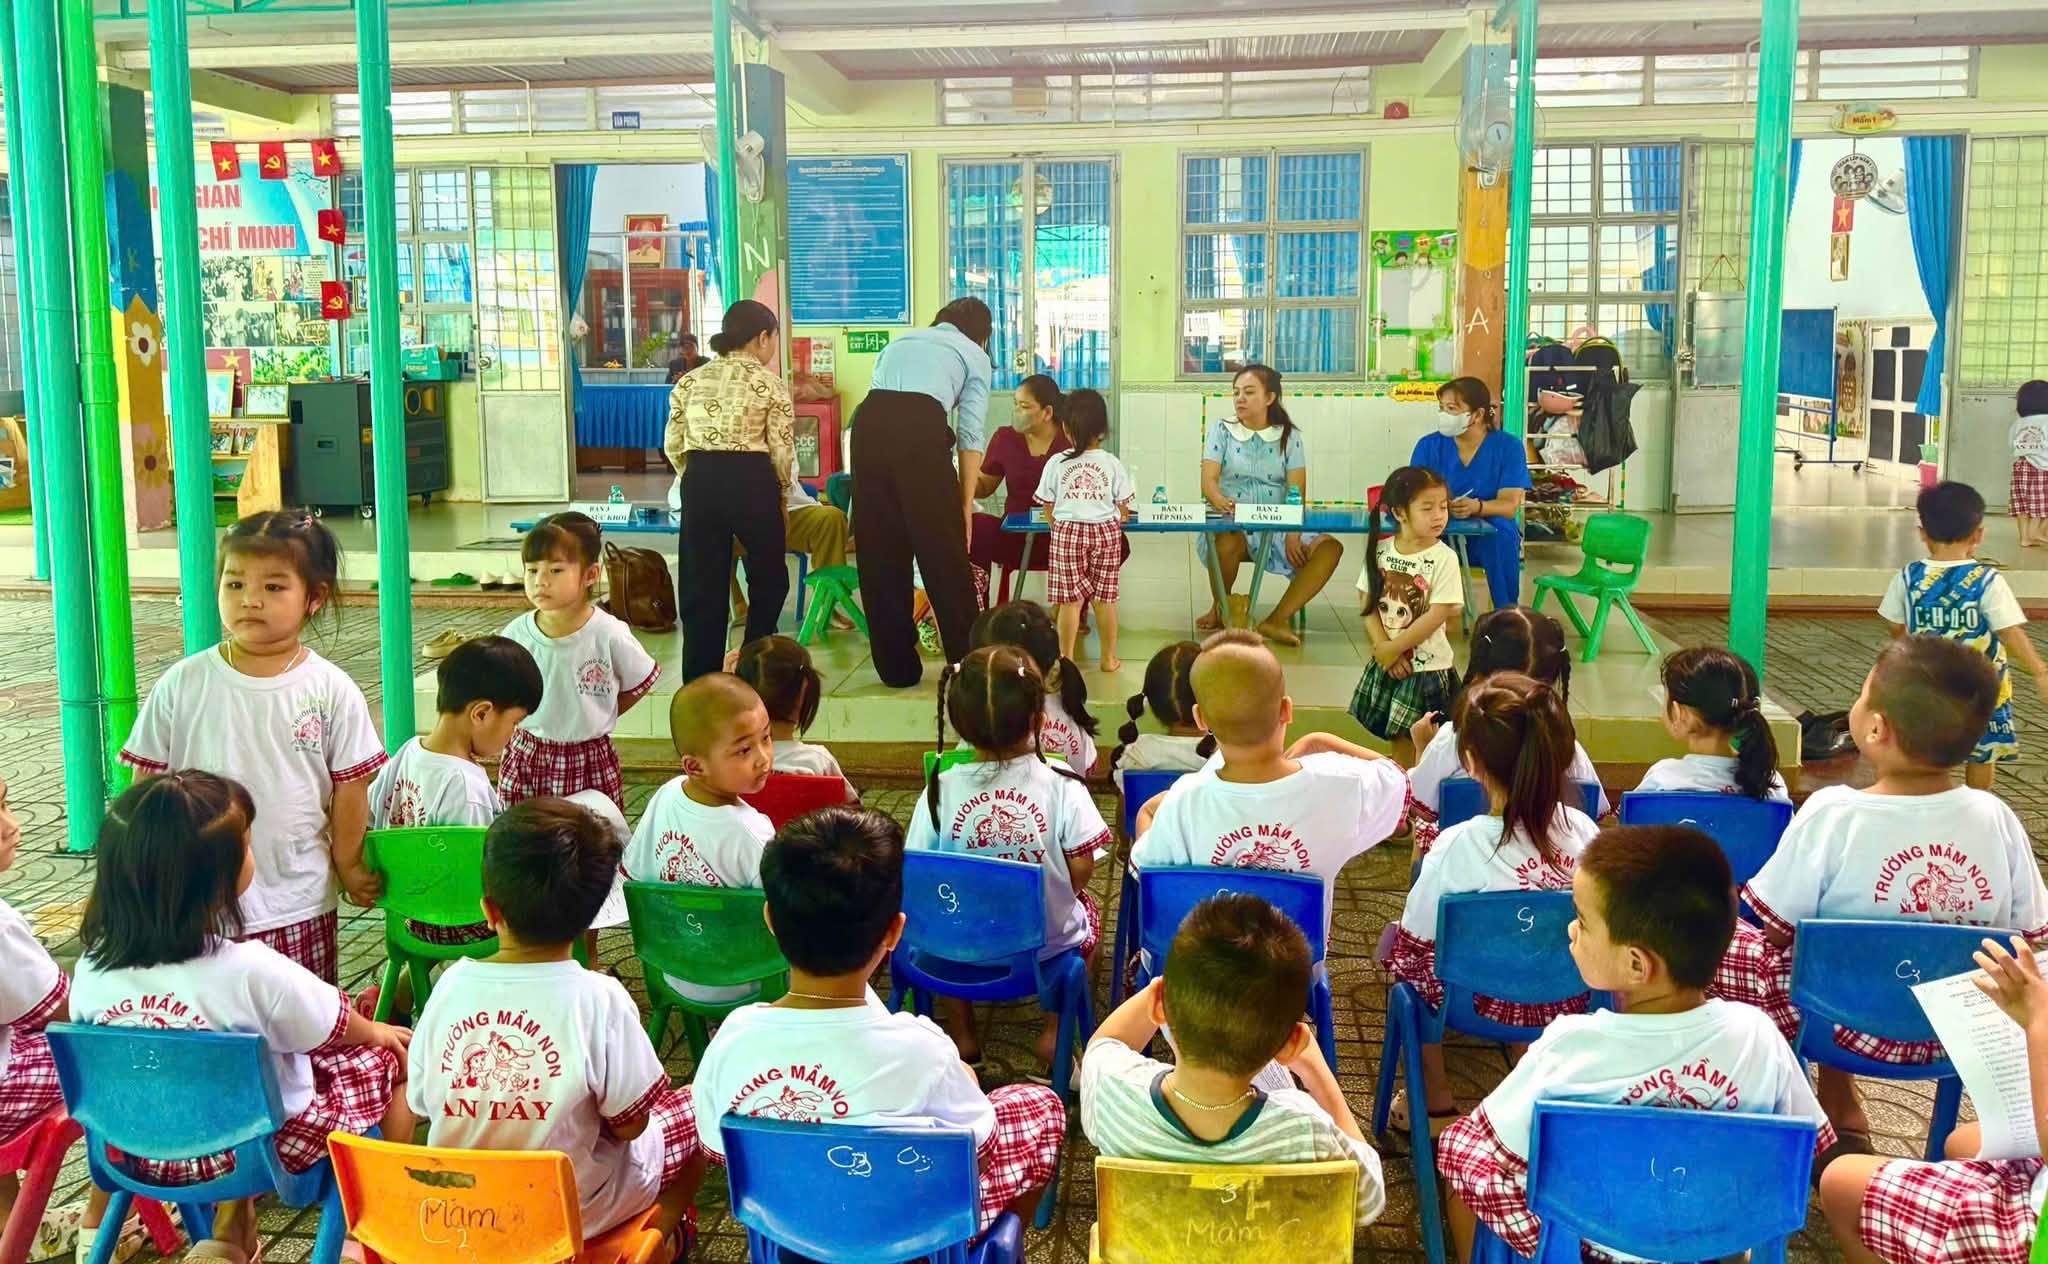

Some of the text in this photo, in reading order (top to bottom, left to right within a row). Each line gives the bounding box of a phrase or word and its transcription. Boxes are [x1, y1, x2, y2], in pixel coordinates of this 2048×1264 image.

[237, 225, 296, 250] MINH
[1465, 306, 1489, 335] A
[1063, 490, 1106, 501] AN TÂY
[1390, 563, 1408, 572] CLUB
[951, 787, 1048, 841] TRƯỜNG MẦM NON
[1210, 825, 1253, 867] RƯỜNG
[1290, 838, 1311, 870] NON
[1874, 845, 1924, 904] TRƯỜNG
[1966, 864, 1993, 902] NON
[685, 912, 703, 936] C3
[1895, 959, 1921, 985] C3
[140, 991, 189, 1017] MẦM
[441, 1008, 562, 1079] TRƯỜNG MẦM NON
[790, 1063, 838, 1095] MẦM
[443, 1095, 553, 1121] AN TÂY
